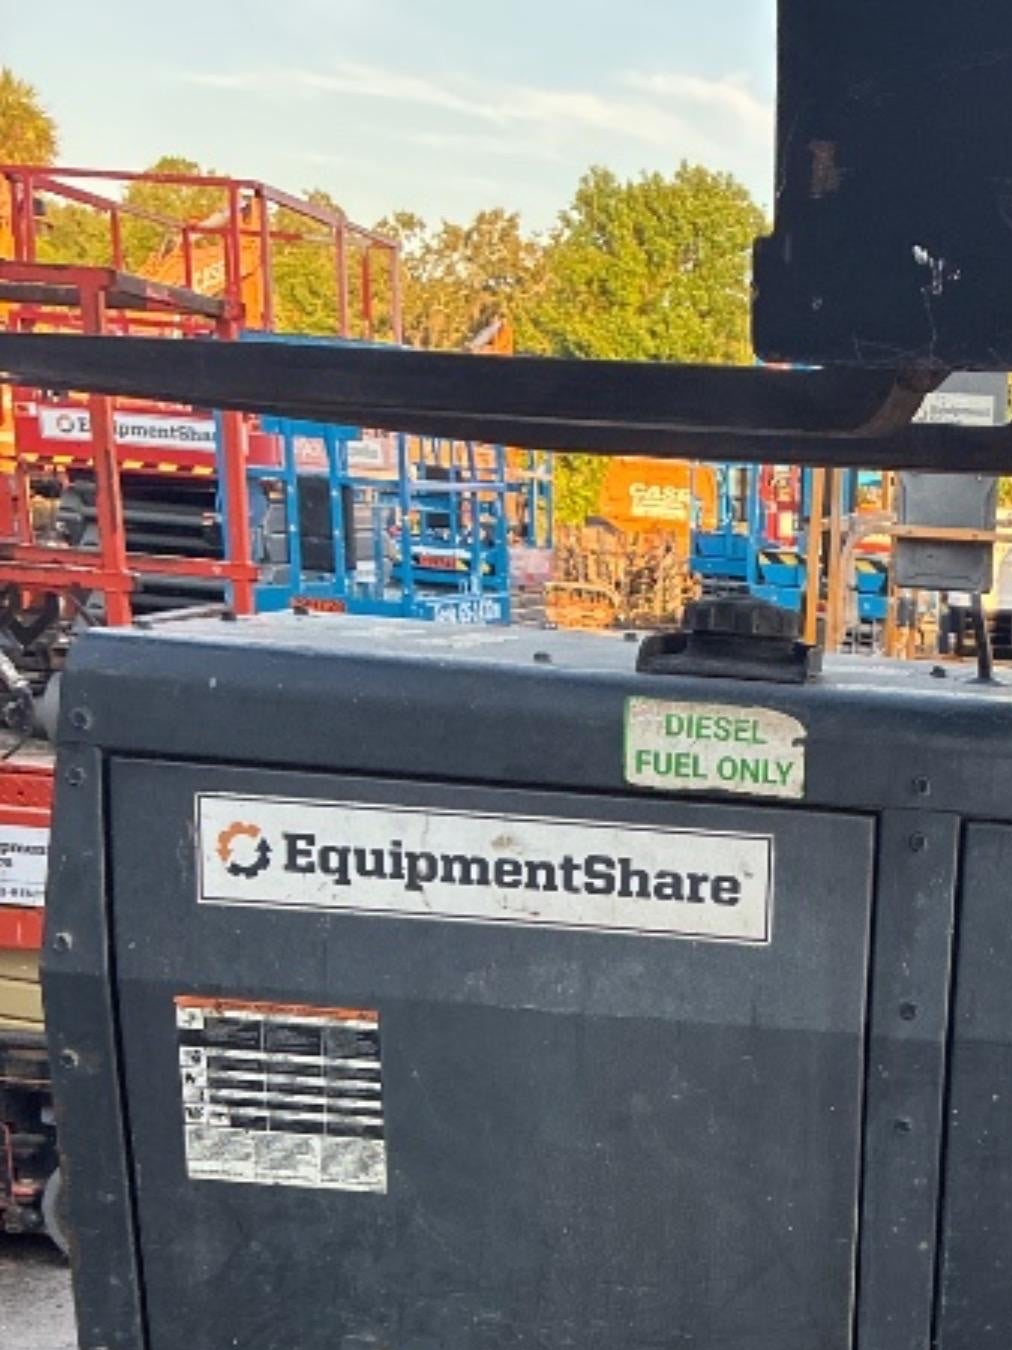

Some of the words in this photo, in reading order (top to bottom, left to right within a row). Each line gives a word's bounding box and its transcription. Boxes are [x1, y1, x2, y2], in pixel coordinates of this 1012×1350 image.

[664, 713, 768, 745] DIESEL
[635, 750, 708, 780] FUEL
[716, 755, 794, 787] ONLY
[282, 832, 741, 907] EquipmentShare
